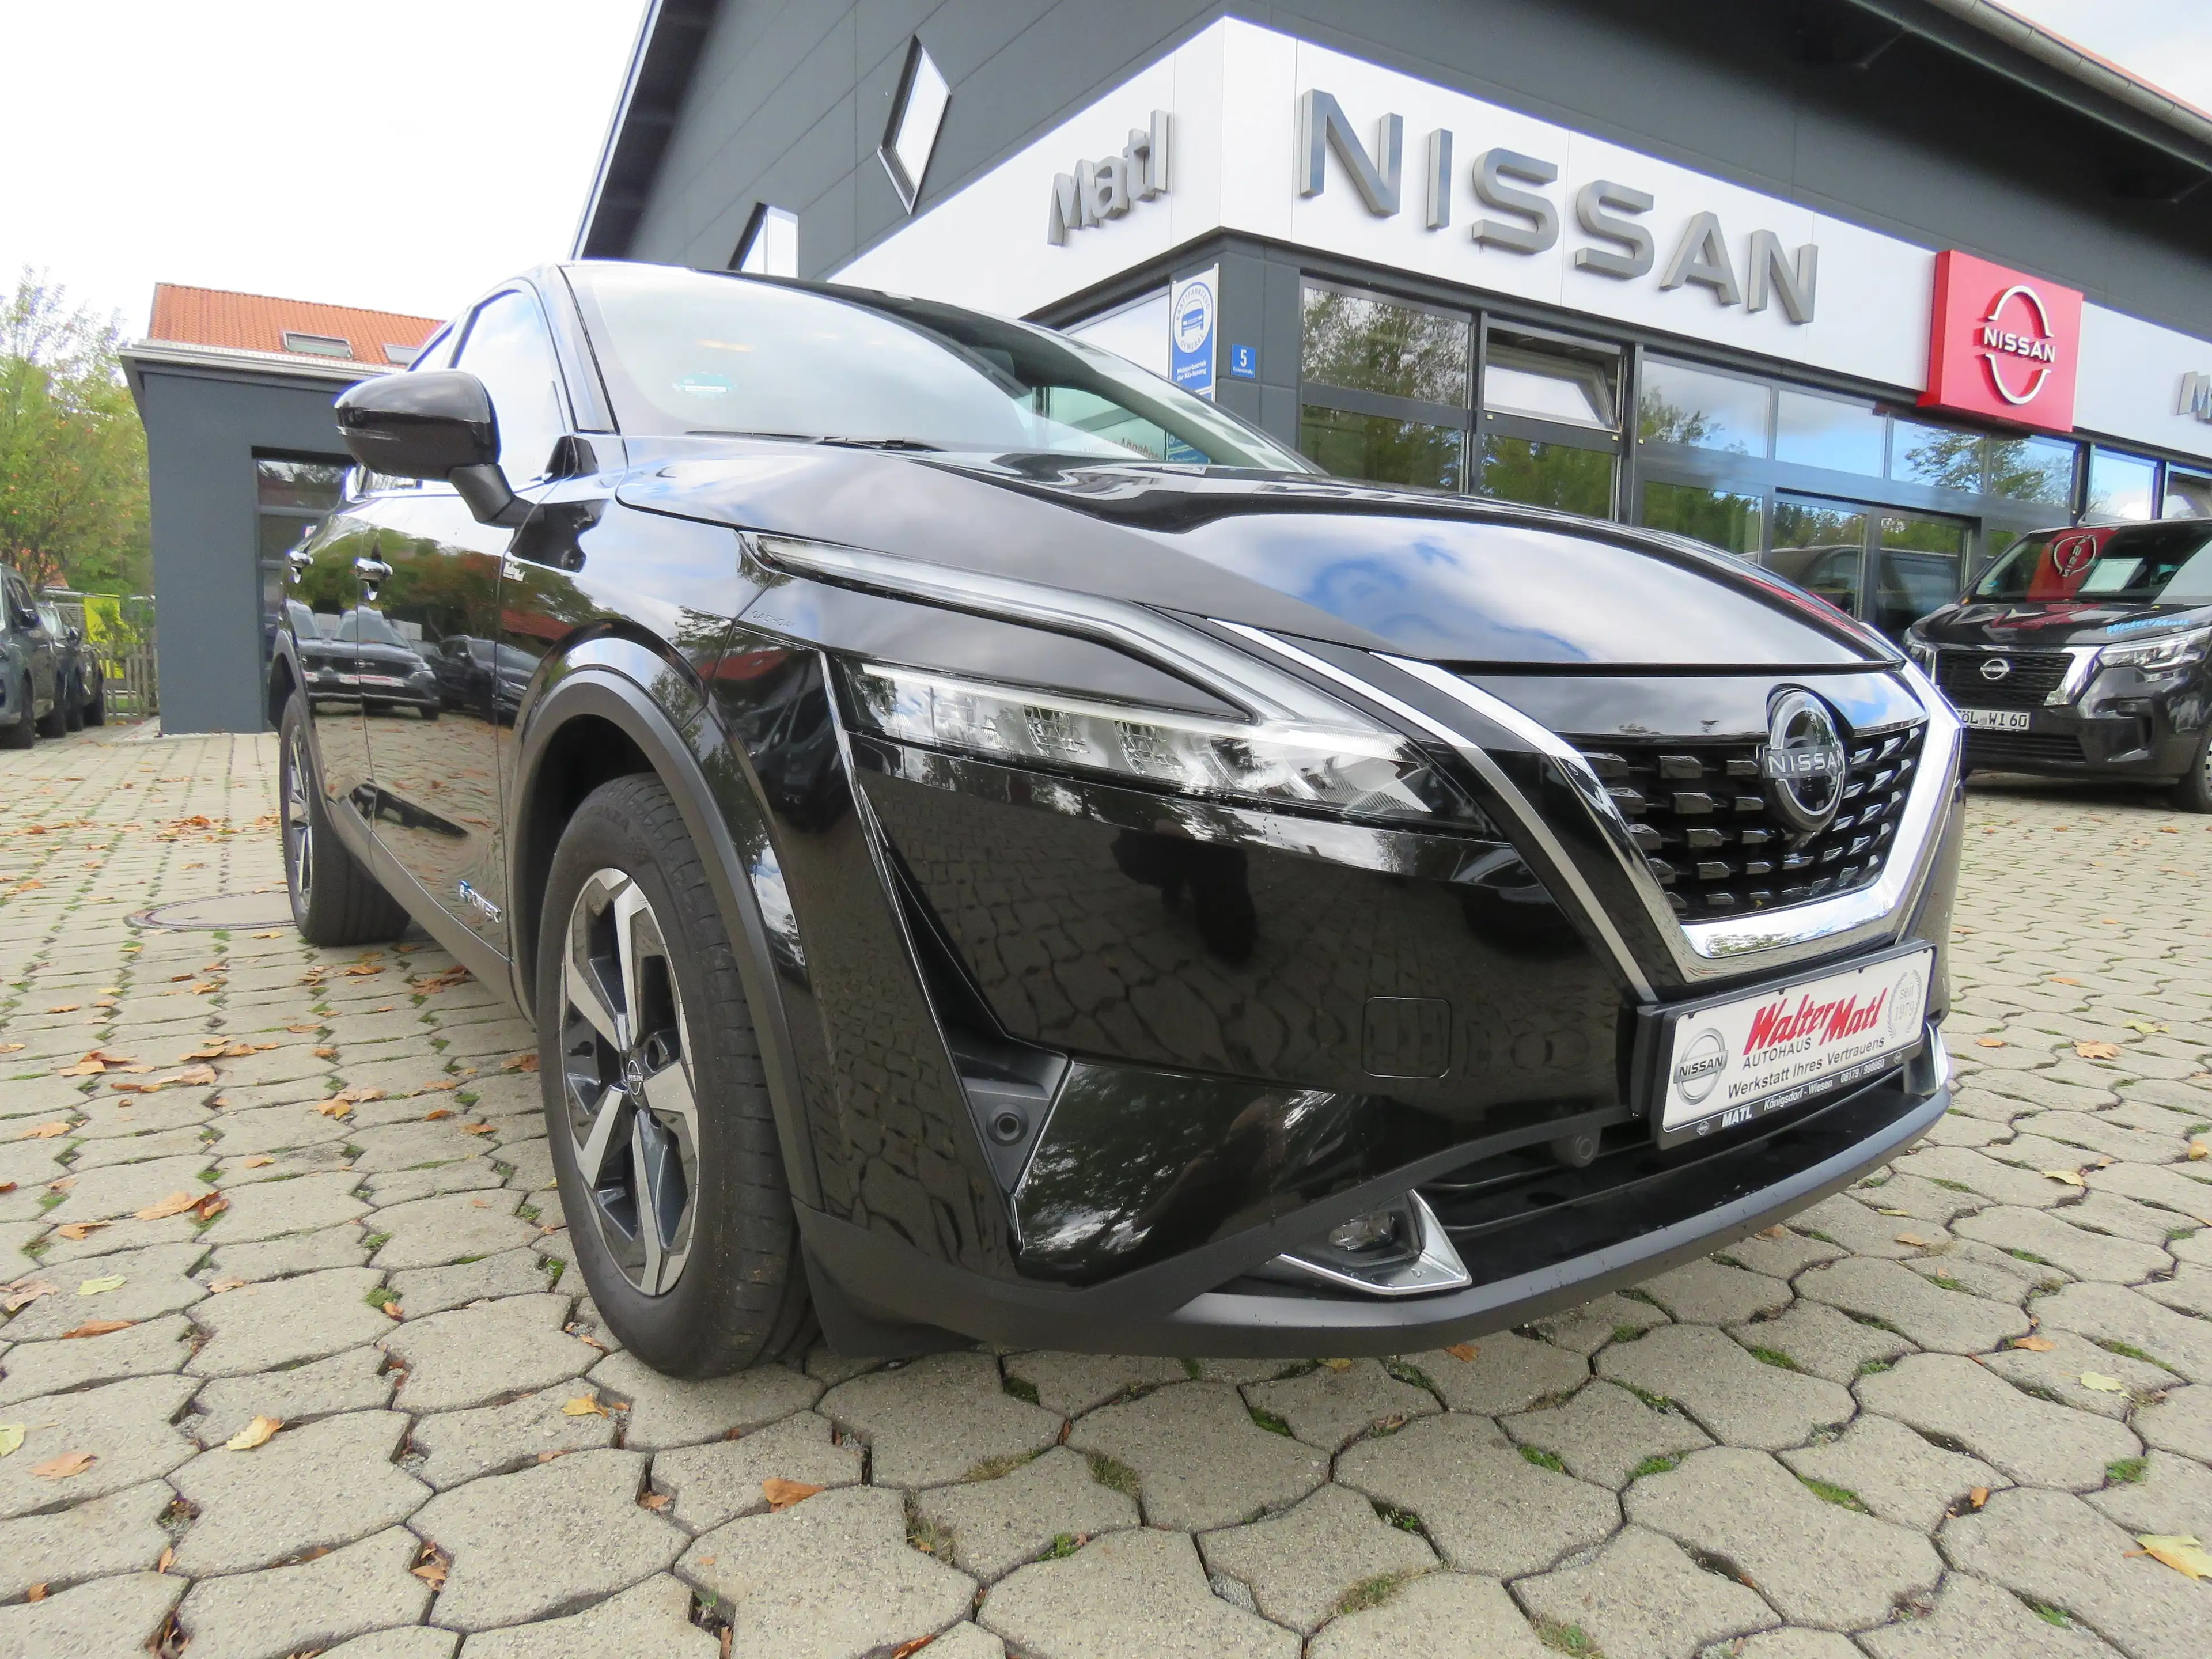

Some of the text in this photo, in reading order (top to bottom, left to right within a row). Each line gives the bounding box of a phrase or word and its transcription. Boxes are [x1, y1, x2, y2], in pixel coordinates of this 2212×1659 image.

[1047, 109, 1171, 247] Matl
[1299, 88, 1819, 325] NISSAN
[1240, 349, 1247, 368] 5
[1983, 326, 2056, 363] NISSAN
[1768, 749, 1843, 774] NISSAN
[1899, 982, 1915, 1001] seit
[1895, 1001, 1917, 1021] 1979
[1679, 1055, 1724, 1078] NISSAN
[1728, 1037, 1885, 1099] Werkstatt Ihres Vertrauens
[1742, 1037, 1812, 1070] AUTOHAUS
[1721, 1105, 1753, 1128] MATL
[1763, 1088, 1804, 1111] Königsdorf
[1808, 1079, 1833, 1095] Wiesen
